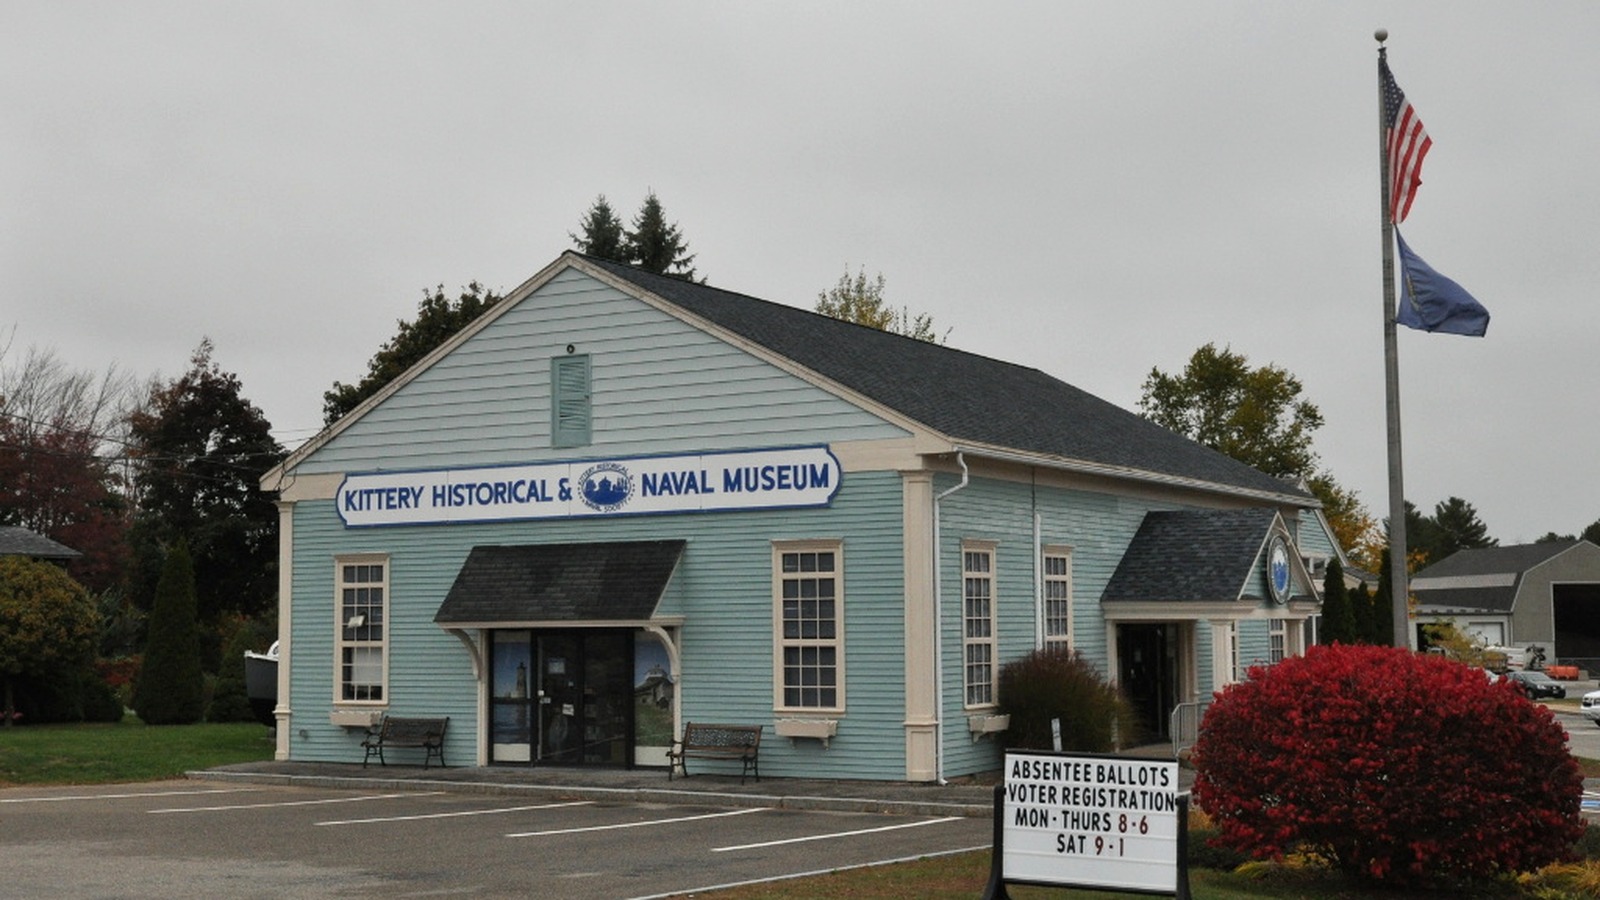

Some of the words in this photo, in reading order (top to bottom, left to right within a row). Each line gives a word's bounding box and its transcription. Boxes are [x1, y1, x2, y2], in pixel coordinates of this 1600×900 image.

[344, 485, 424, 512] KITTERY
[433, 479, 553, 508] HISTORICAL
[558, 478, 573, 501] &
[641, 471, 715, 497] NAVAL
[723, 463, 830, 493] MUSEUM
[1012, 760, 1092, 783] ABSENTEE
[1096, 764, 1169, 787] BALLOTS
[1008, 783, 1057, 805] VOTER
[1062, 786, 1175, 812] REGISTRATION
[1056, 833, 1086, 853] SAT
